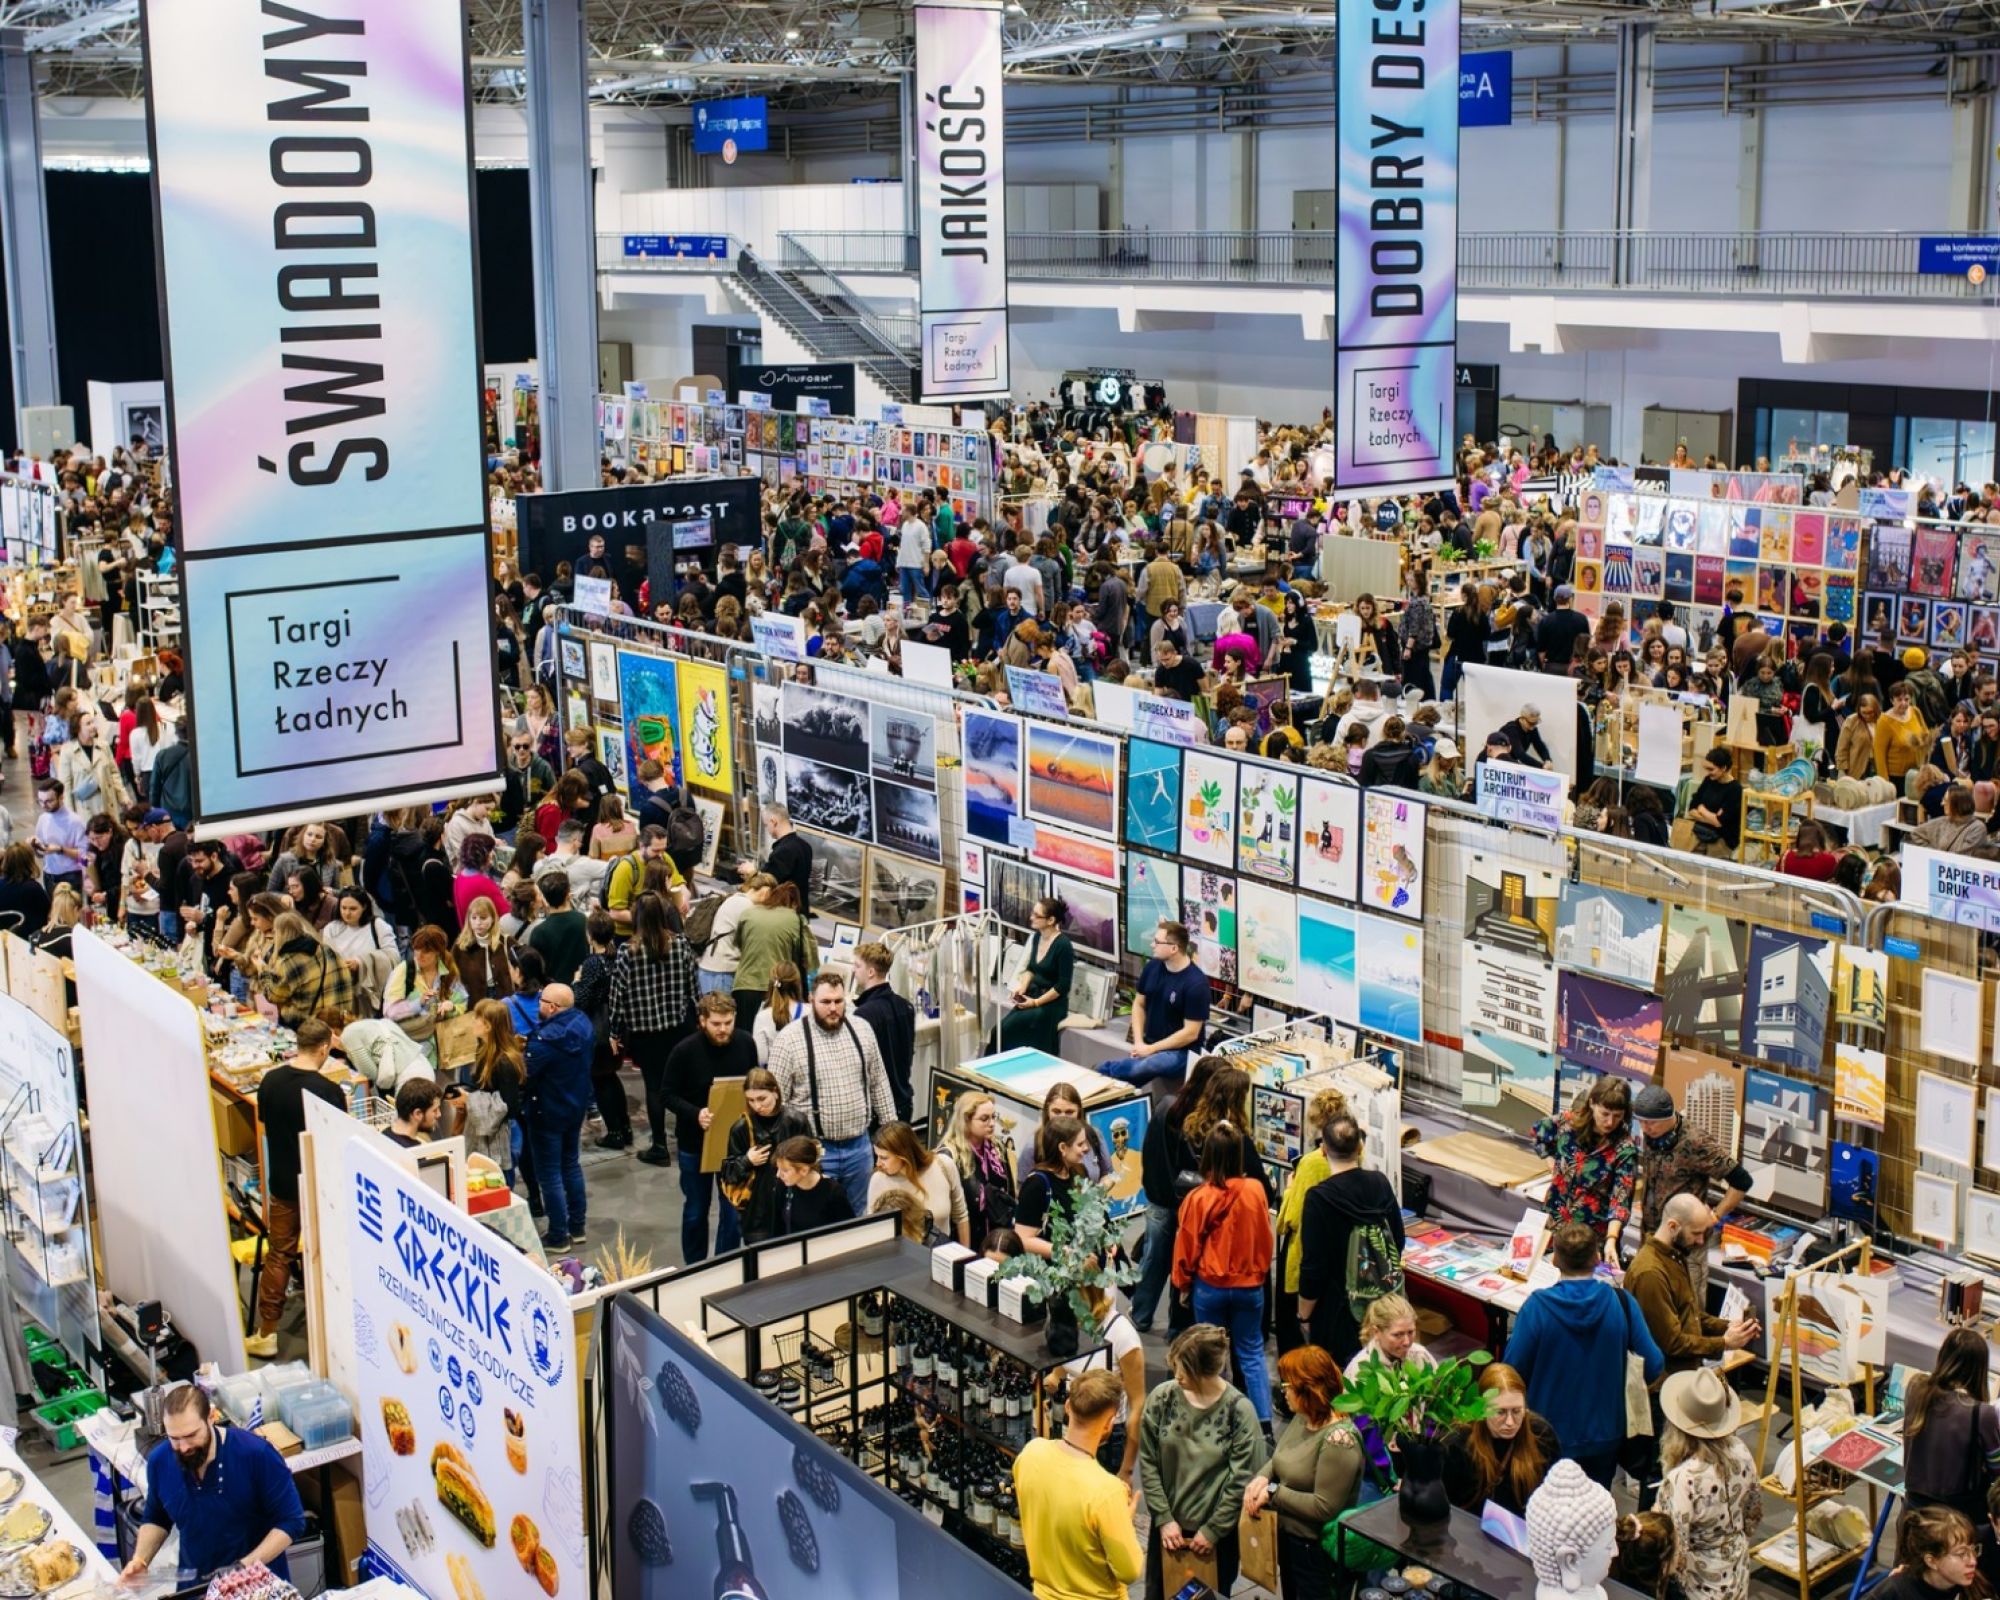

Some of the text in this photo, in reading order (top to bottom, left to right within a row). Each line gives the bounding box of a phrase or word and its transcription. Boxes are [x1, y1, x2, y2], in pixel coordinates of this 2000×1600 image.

[1476, 72, 1494, 98] A
[925, 85, 988, 264] JAKOŚĆ
[1371, 114, 1425, 317] DOBRY
[258, 0, 389, 486] ŚWIADOMY
[944, 332, 967, 345] Targi
[944, 347, 978, 357] Rzeczy
[944, 359, 982, 372] Ładnych
[1369, 382, 1400, 402] Targi
[1369, 407, 1413, 424] Rzeczy
[1368, 426, 1421, 448] Ładnych
[268, 609, 350, 648] Targi
[273, 658, 388, 690] Rzeczy
[275, 688, 408, 735] Ładnych
[1483, 768, 1527, 787] CENTRUM
[1483, 782, 1551, 805] ARCHITEKTURY
[1938, 865, 1980, 887] PAPIER
[1938, 880, 1970, 899] DRUK
[397, 1188, 501, 1285] TRADYCYJNE
[393, 1220, 512, 1355] GRECKIE
[378, 1265, 466, 1352] RZEMIEŚLNICZE
[468, 1338, 536, 1408] SŁODYCZE
